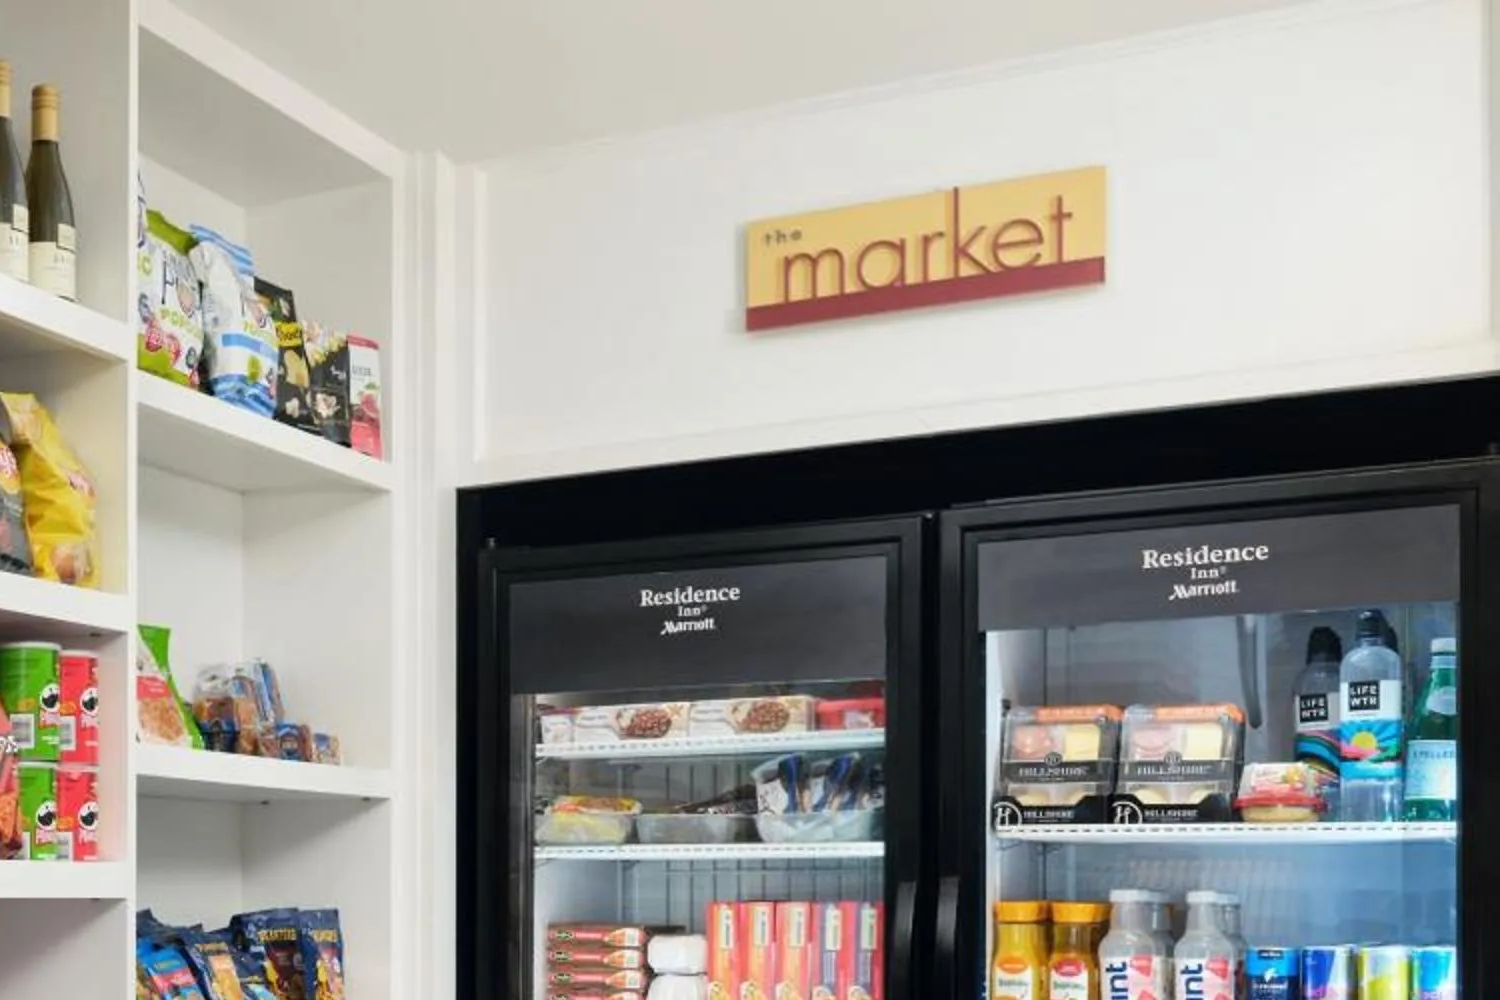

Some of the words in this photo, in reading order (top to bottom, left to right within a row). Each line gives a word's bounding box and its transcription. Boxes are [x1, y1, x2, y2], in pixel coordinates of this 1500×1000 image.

[765, 229, 802, 246] the
[784, 187, 1073, 303] market
[1140, 545, 1269, 569] Residence
[1190, 567, 1220, 580] Inn
[639, 586, 741, 608] Residence
[1168, 580, 1239, 601] Marriott
[677, 605, 701, 617] Inn
[660, 618, 715, 636] Marriott
[1350, 685, 1377, 696] LIFE
[1301, 699, 1325, 709] LIFE
